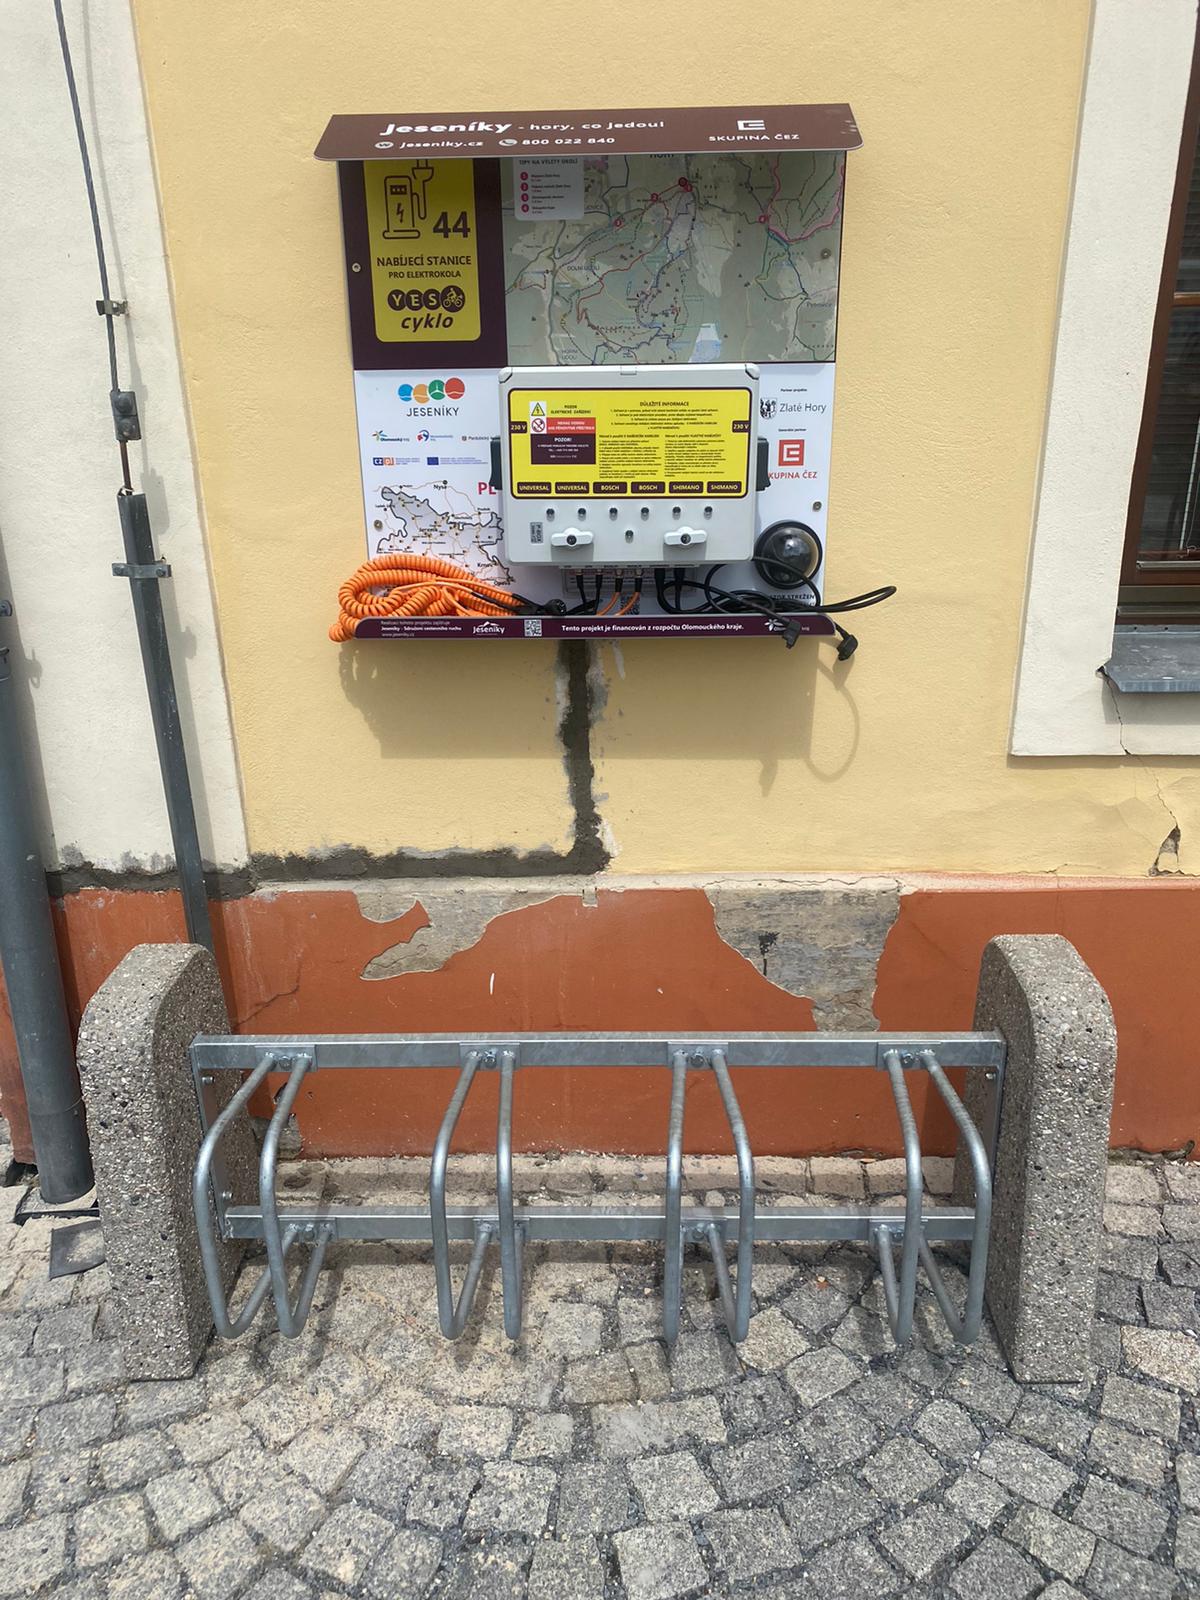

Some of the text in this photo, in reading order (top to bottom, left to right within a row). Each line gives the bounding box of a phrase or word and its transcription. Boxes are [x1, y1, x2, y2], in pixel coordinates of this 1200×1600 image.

[379, 121, 513, 136] Jeseníky
[521, 136, 616, 146] 800 022 840
[708, 132, 800, 142] SKUPINA ČEZ
[432, 211, 471, 239] 44
[377, 254, 472, 267] NABÍJECÍ STANICE
[388, 270, 461, 279] PRO ELEKTROKOLA
[391, 293, 437, 307] YES
[401, 313, 454, 333] cyklo
[406, 404, 460, 417] JESENÍKY
[779, 402, 827, 415] Zlaté Hory
[768, 469, 818, 480] KUPINA ČEZ
[580, 624, 604, 633] projekt
[604, 624, 611, 633] je
[652, 624, 681, 633] rozpočtu
[681, 623, 726, 631] Olomouckého
[726, 623, 745, 632] kraje.
